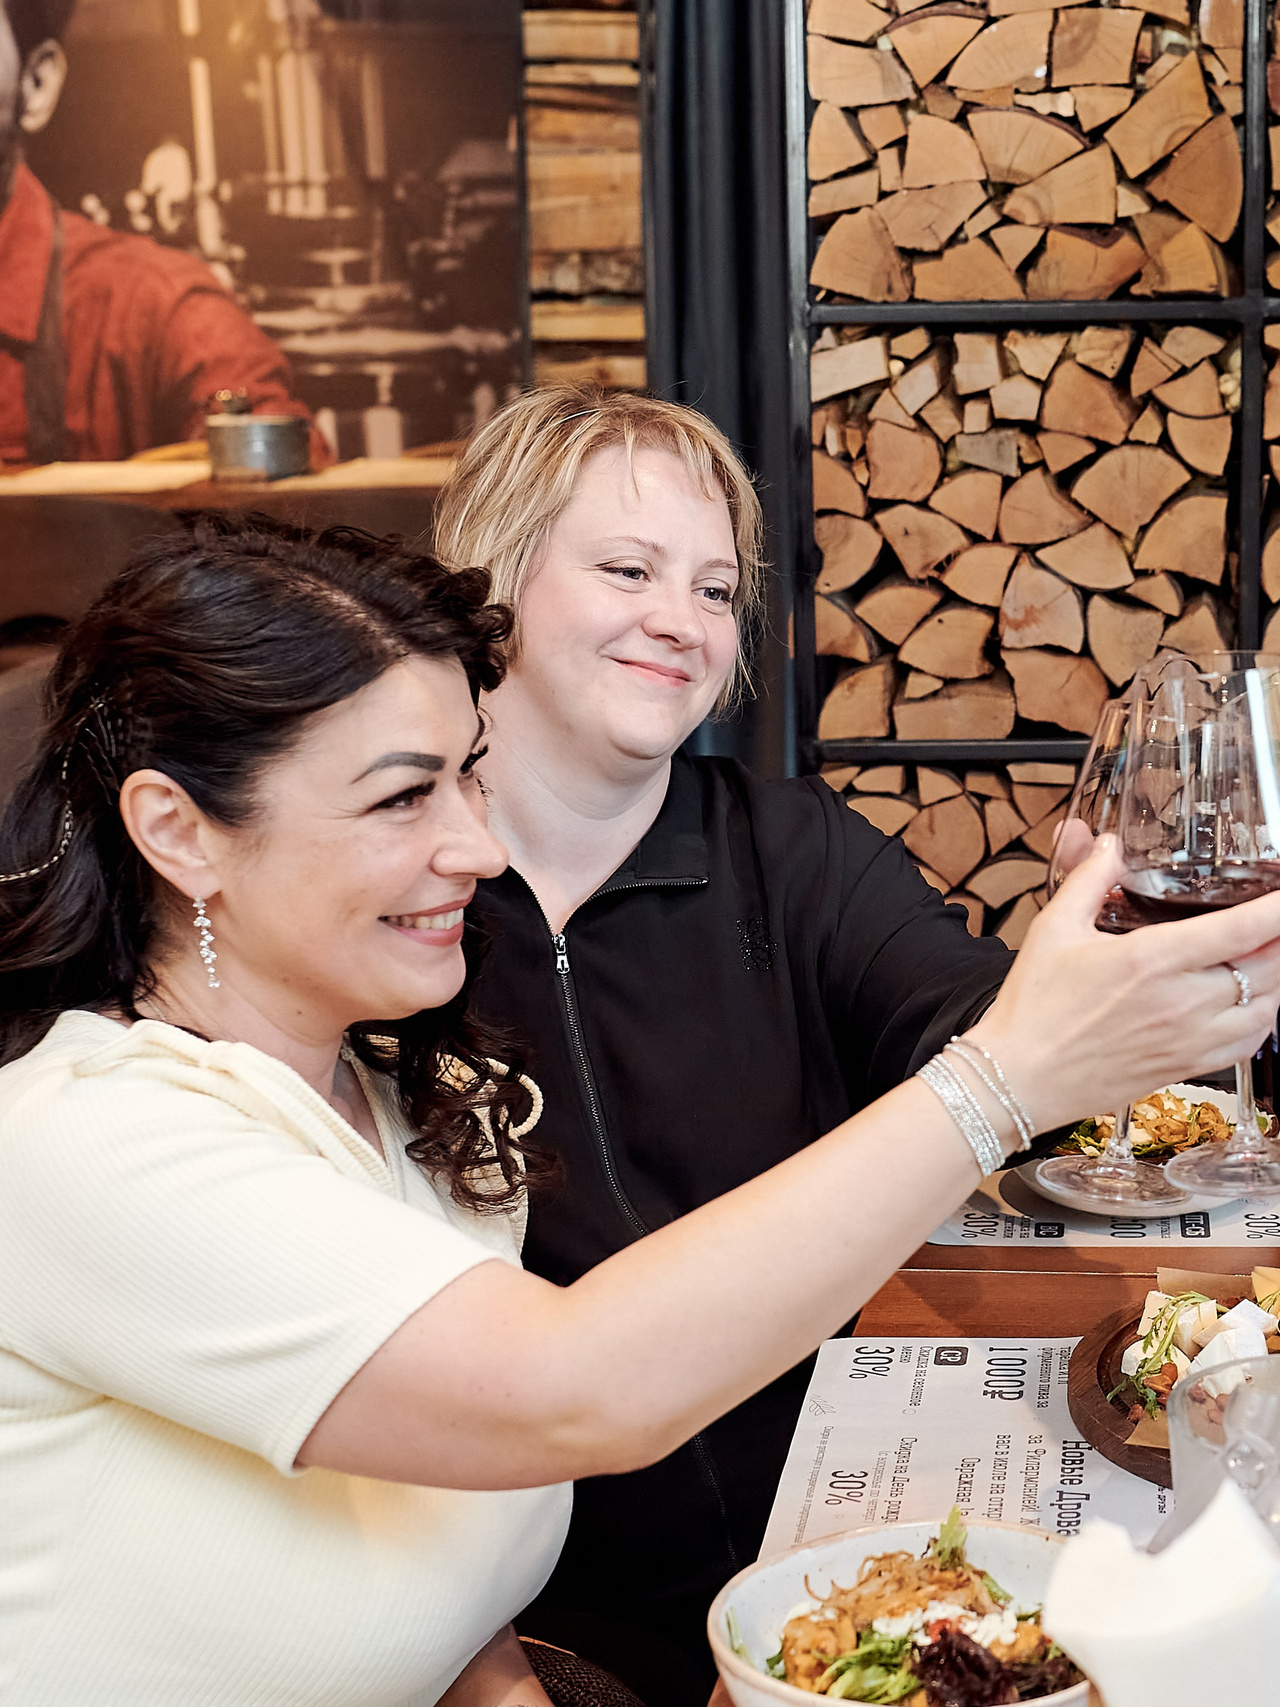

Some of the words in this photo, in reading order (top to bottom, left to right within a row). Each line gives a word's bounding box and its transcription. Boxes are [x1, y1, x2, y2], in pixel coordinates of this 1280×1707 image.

[960, 1212, 1000, 1239] 30%
[1243, 1213, 1280, 1239] 30%
[848, 1345, 896, 1379] 30%
[894, 1436, 918, 1464] Скидка
[995, 1434, 1013, 1450] вас
[1028, 1434, 1044, 1445] за
[893, 1465, 908, 1474] на
[991, 1457, 1010, 1481] июле
[1059, 1439, 1093, 1487] Новые
[825, 1470, 869, 1506] 30%
[889, 1475, 910, 1498] День
[954, 1457, 981, 1503] Овражная
[989, 1483, 1004, 1496] на
[1019, 1448, 1047, 1513] Филармонией!
[1050, 1490, 1091, 1537] Дрова
